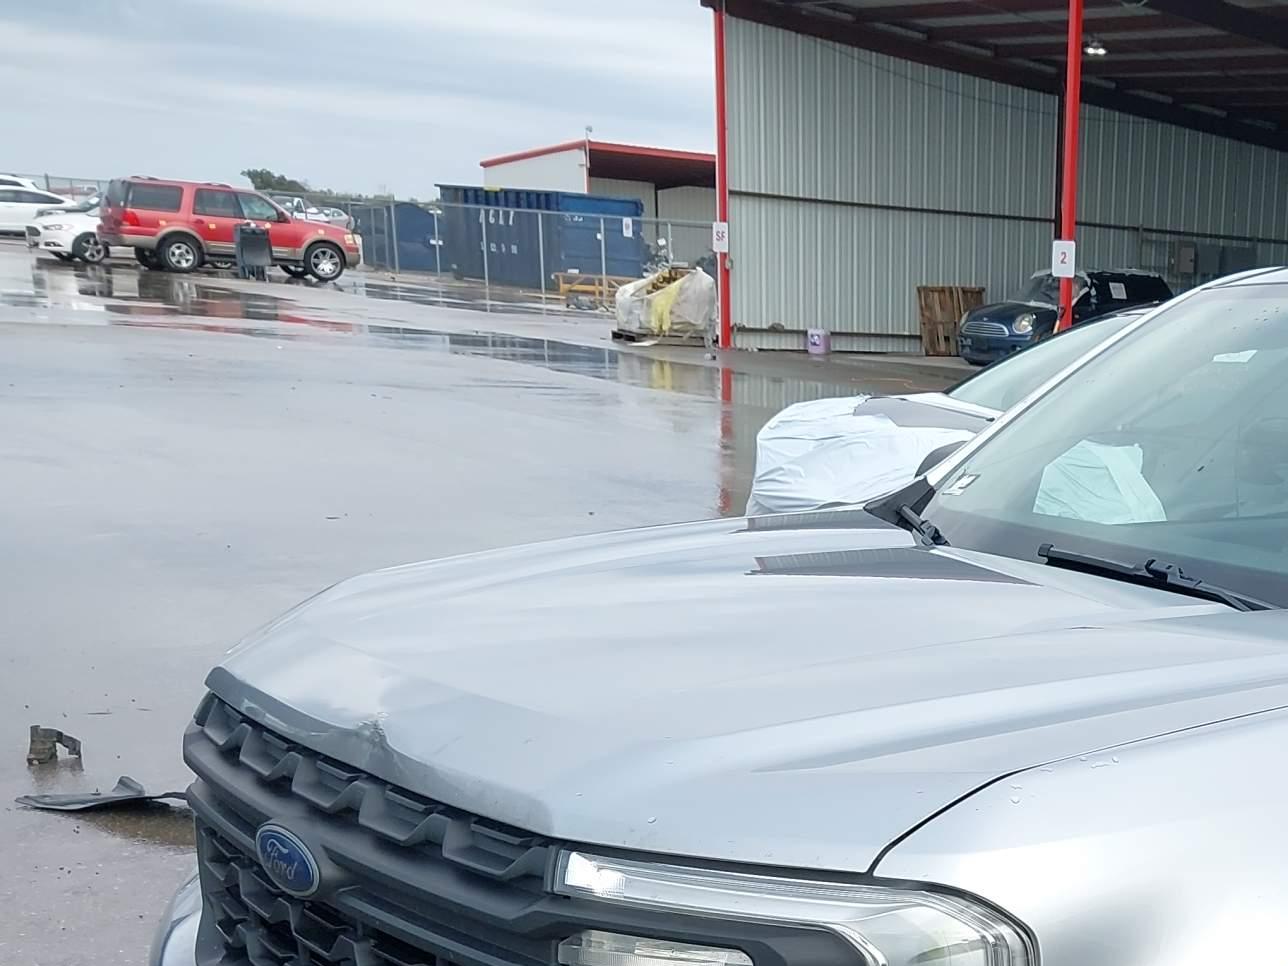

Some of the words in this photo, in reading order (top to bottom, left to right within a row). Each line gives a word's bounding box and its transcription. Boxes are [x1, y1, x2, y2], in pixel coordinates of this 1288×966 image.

[715, 230, 726, 241] SF
[1060, 251, 1067, 265] 2
[264, 838, 298, 880] Ford
